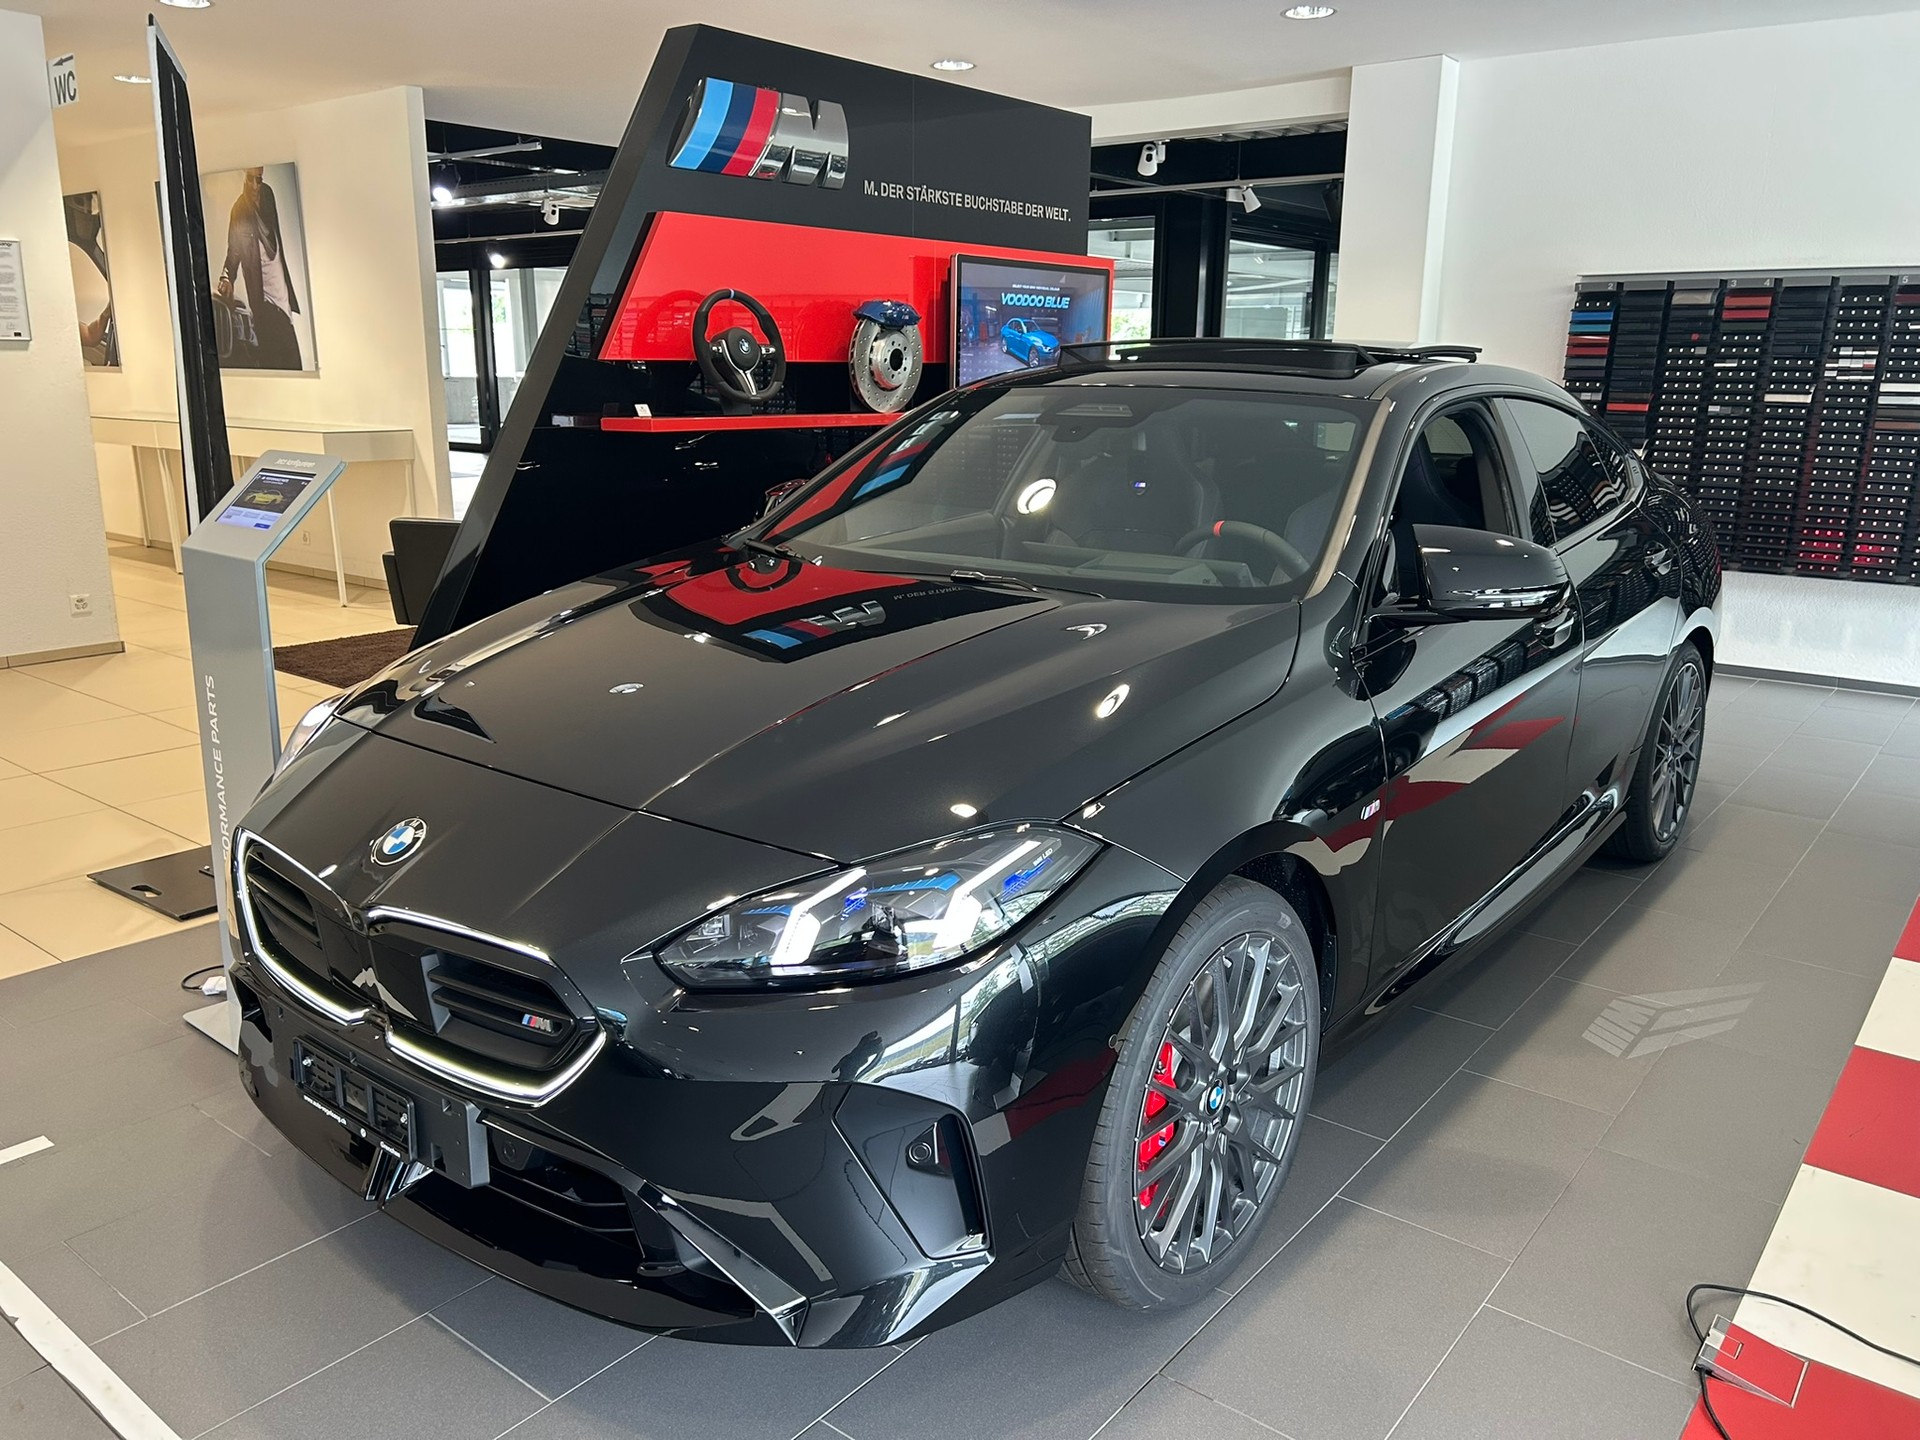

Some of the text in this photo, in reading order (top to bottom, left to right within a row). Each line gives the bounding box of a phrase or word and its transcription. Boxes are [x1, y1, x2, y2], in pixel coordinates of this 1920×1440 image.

[54, 70, 77, 105] WC
[864, 179, 1071, 222] M. DER STÄRKSTE BUCHSTABE DER WELT.
[1607, 282, 1614, 290] 2
[1730, 279, 1737, 288] 3
[1763, 278, 1770, 287] 4
[1902, 275, 1909, 284] 5
[1001, 292, 1071, 309] VOODOO BLUE
[205, 674, 221, 745] PARTS
